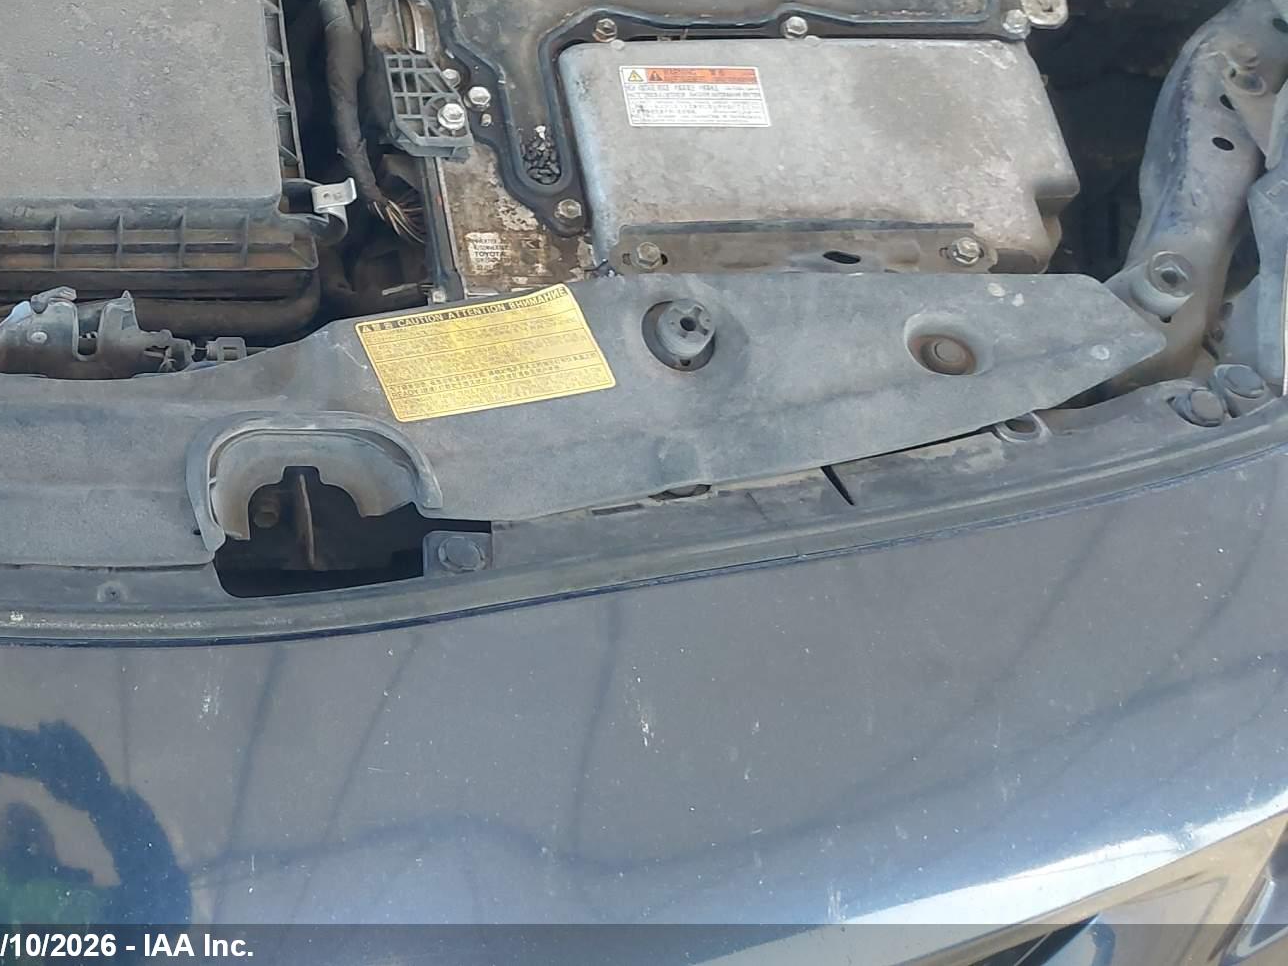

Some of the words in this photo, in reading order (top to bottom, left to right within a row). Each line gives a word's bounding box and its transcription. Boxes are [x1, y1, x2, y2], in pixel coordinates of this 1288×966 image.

[397, 312, 443, 328] CAUTION
[448, 303, 506, 321] ATTENTION
[509, 287, 569, 311] ВНИМАНИЕ
